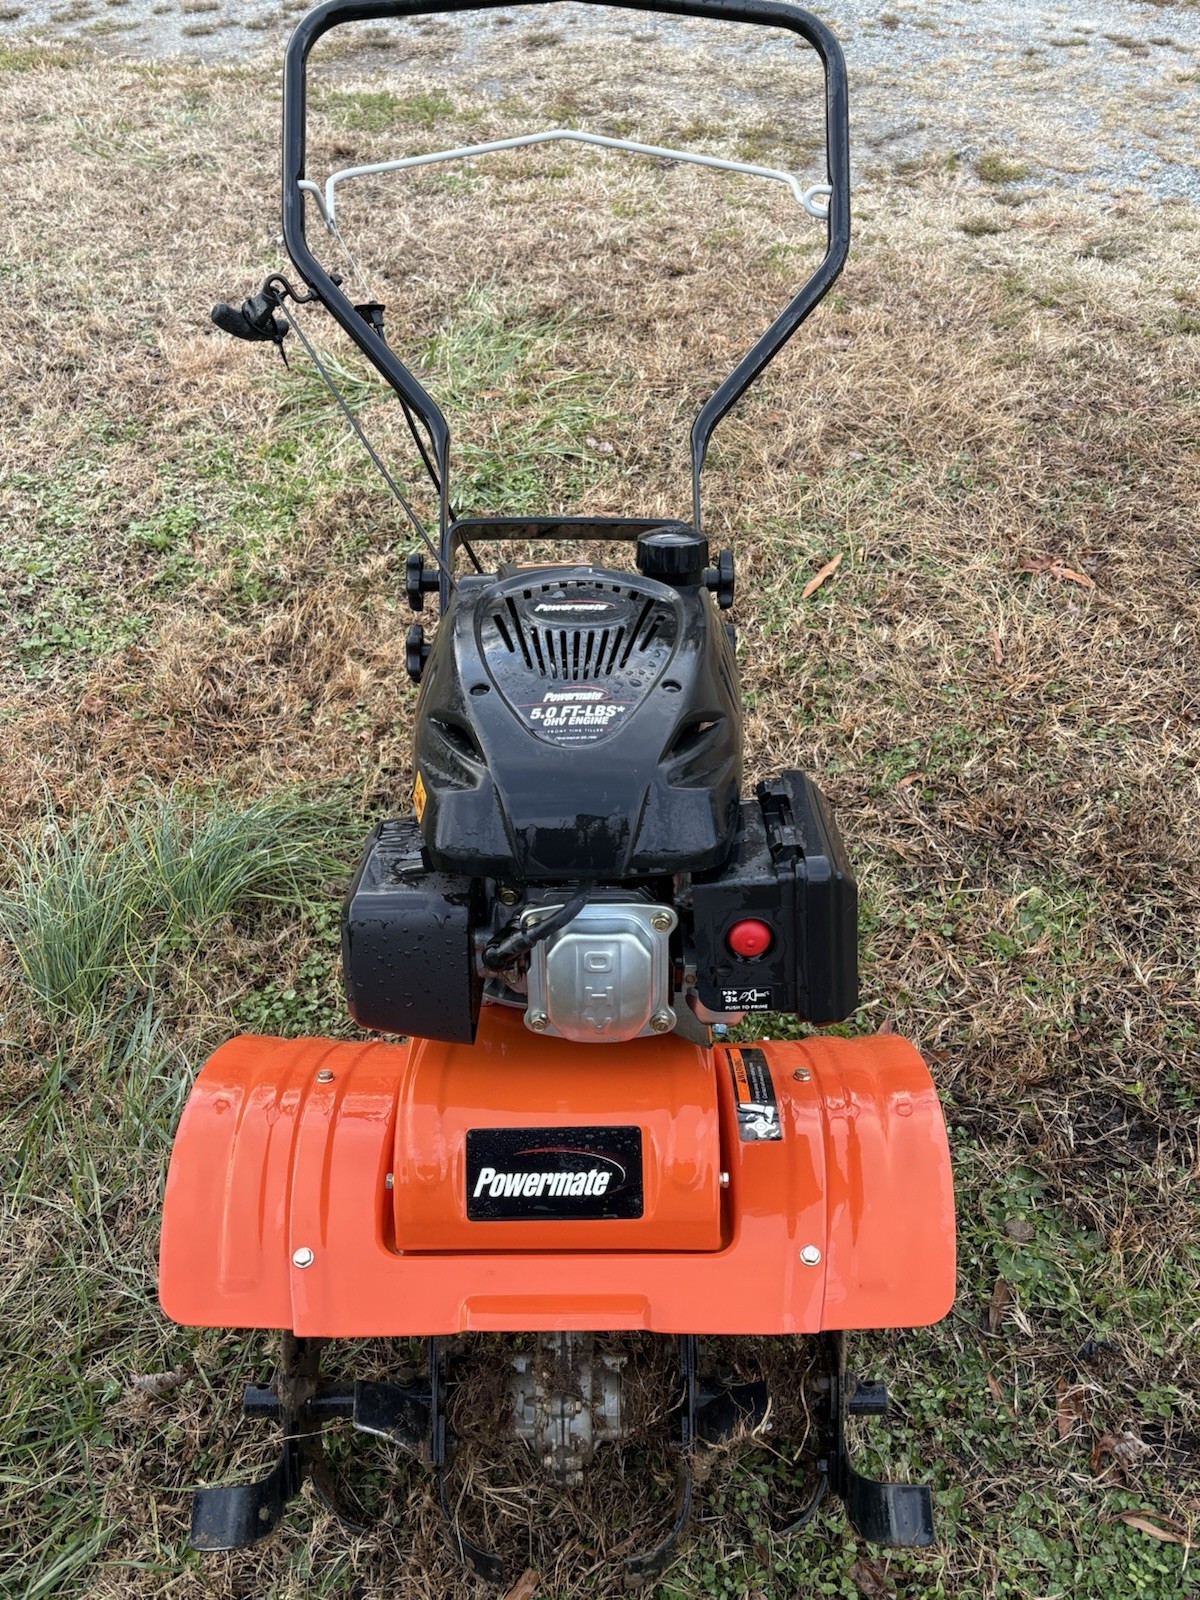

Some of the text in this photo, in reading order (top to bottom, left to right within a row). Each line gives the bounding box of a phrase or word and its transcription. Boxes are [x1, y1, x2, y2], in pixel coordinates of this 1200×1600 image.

[534, 603, 608, 612] Powermate
[543, 692, 603, 702] Powermate
[530, 706, 557, 719] 5.0
[543, 716, 609, 727] OHV ENGINE
[733, 1058, 747, 1080] WARNING
[473, 1167, 611, 1198] Powermate
